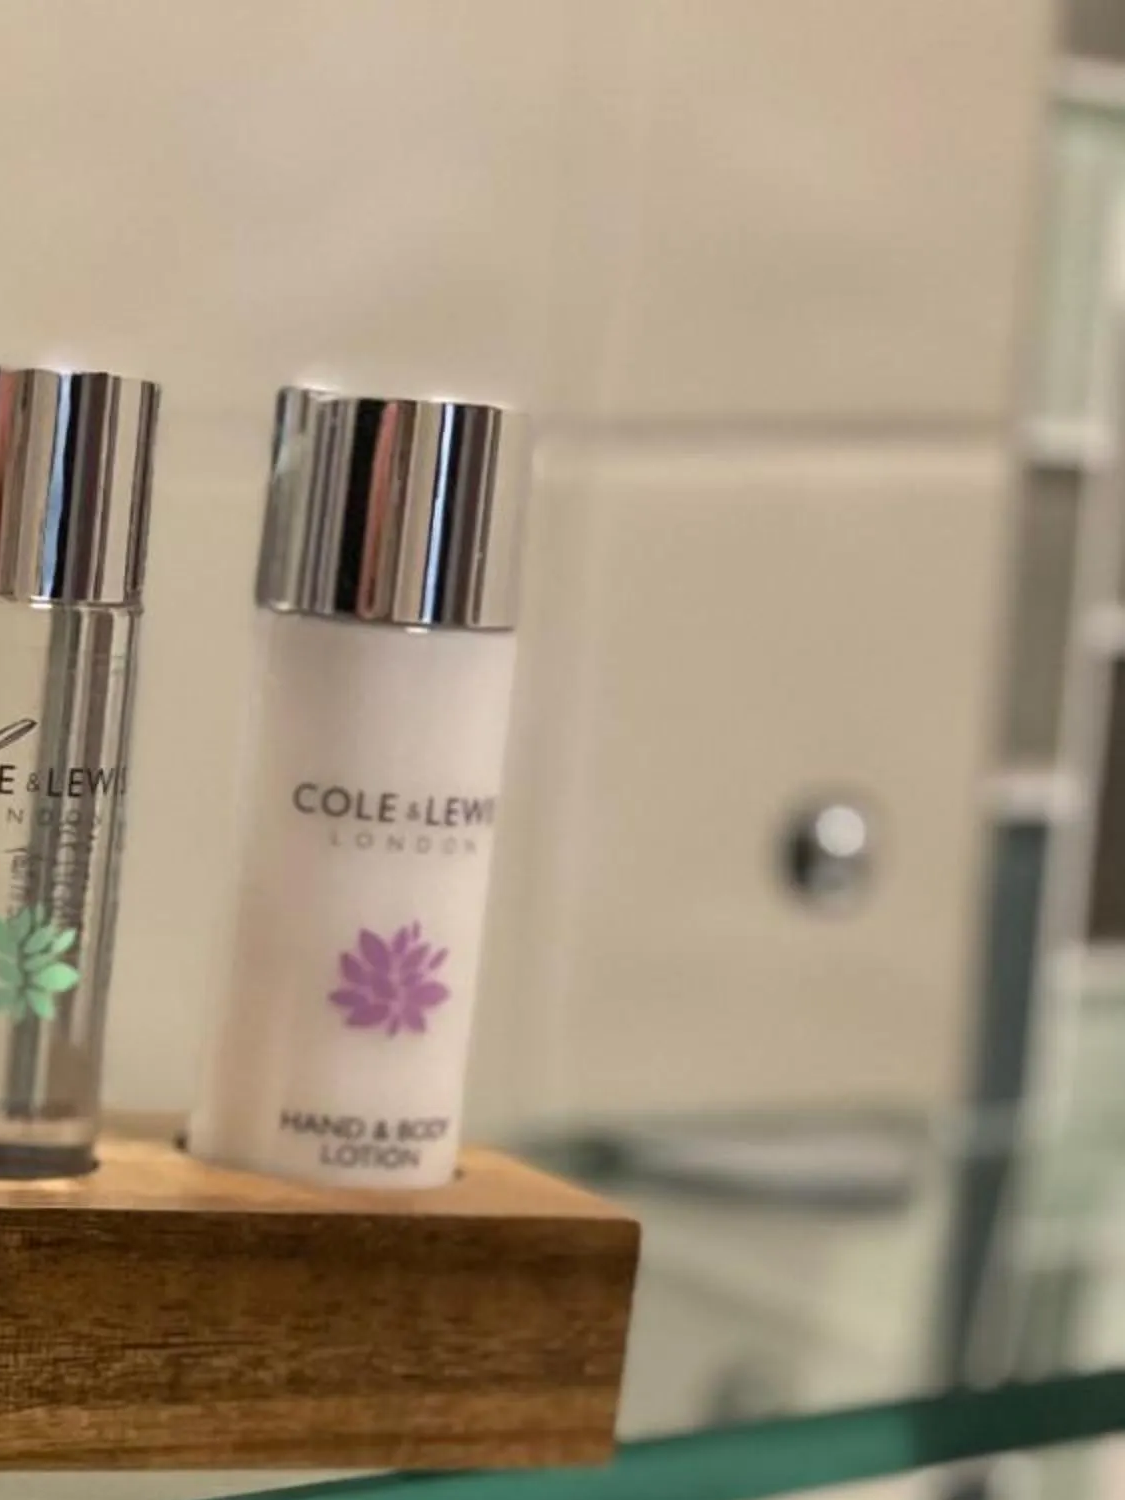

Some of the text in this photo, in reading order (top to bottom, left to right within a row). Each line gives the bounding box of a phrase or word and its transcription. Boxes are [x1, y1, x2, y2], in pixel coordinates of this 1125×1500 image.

[292, 781, 399, 823] COLE
[330, 829, 477, 855] LONDON
[279, 1110, 366, 1140] HAND
[319, 1143, 421, 1169] LOTION
